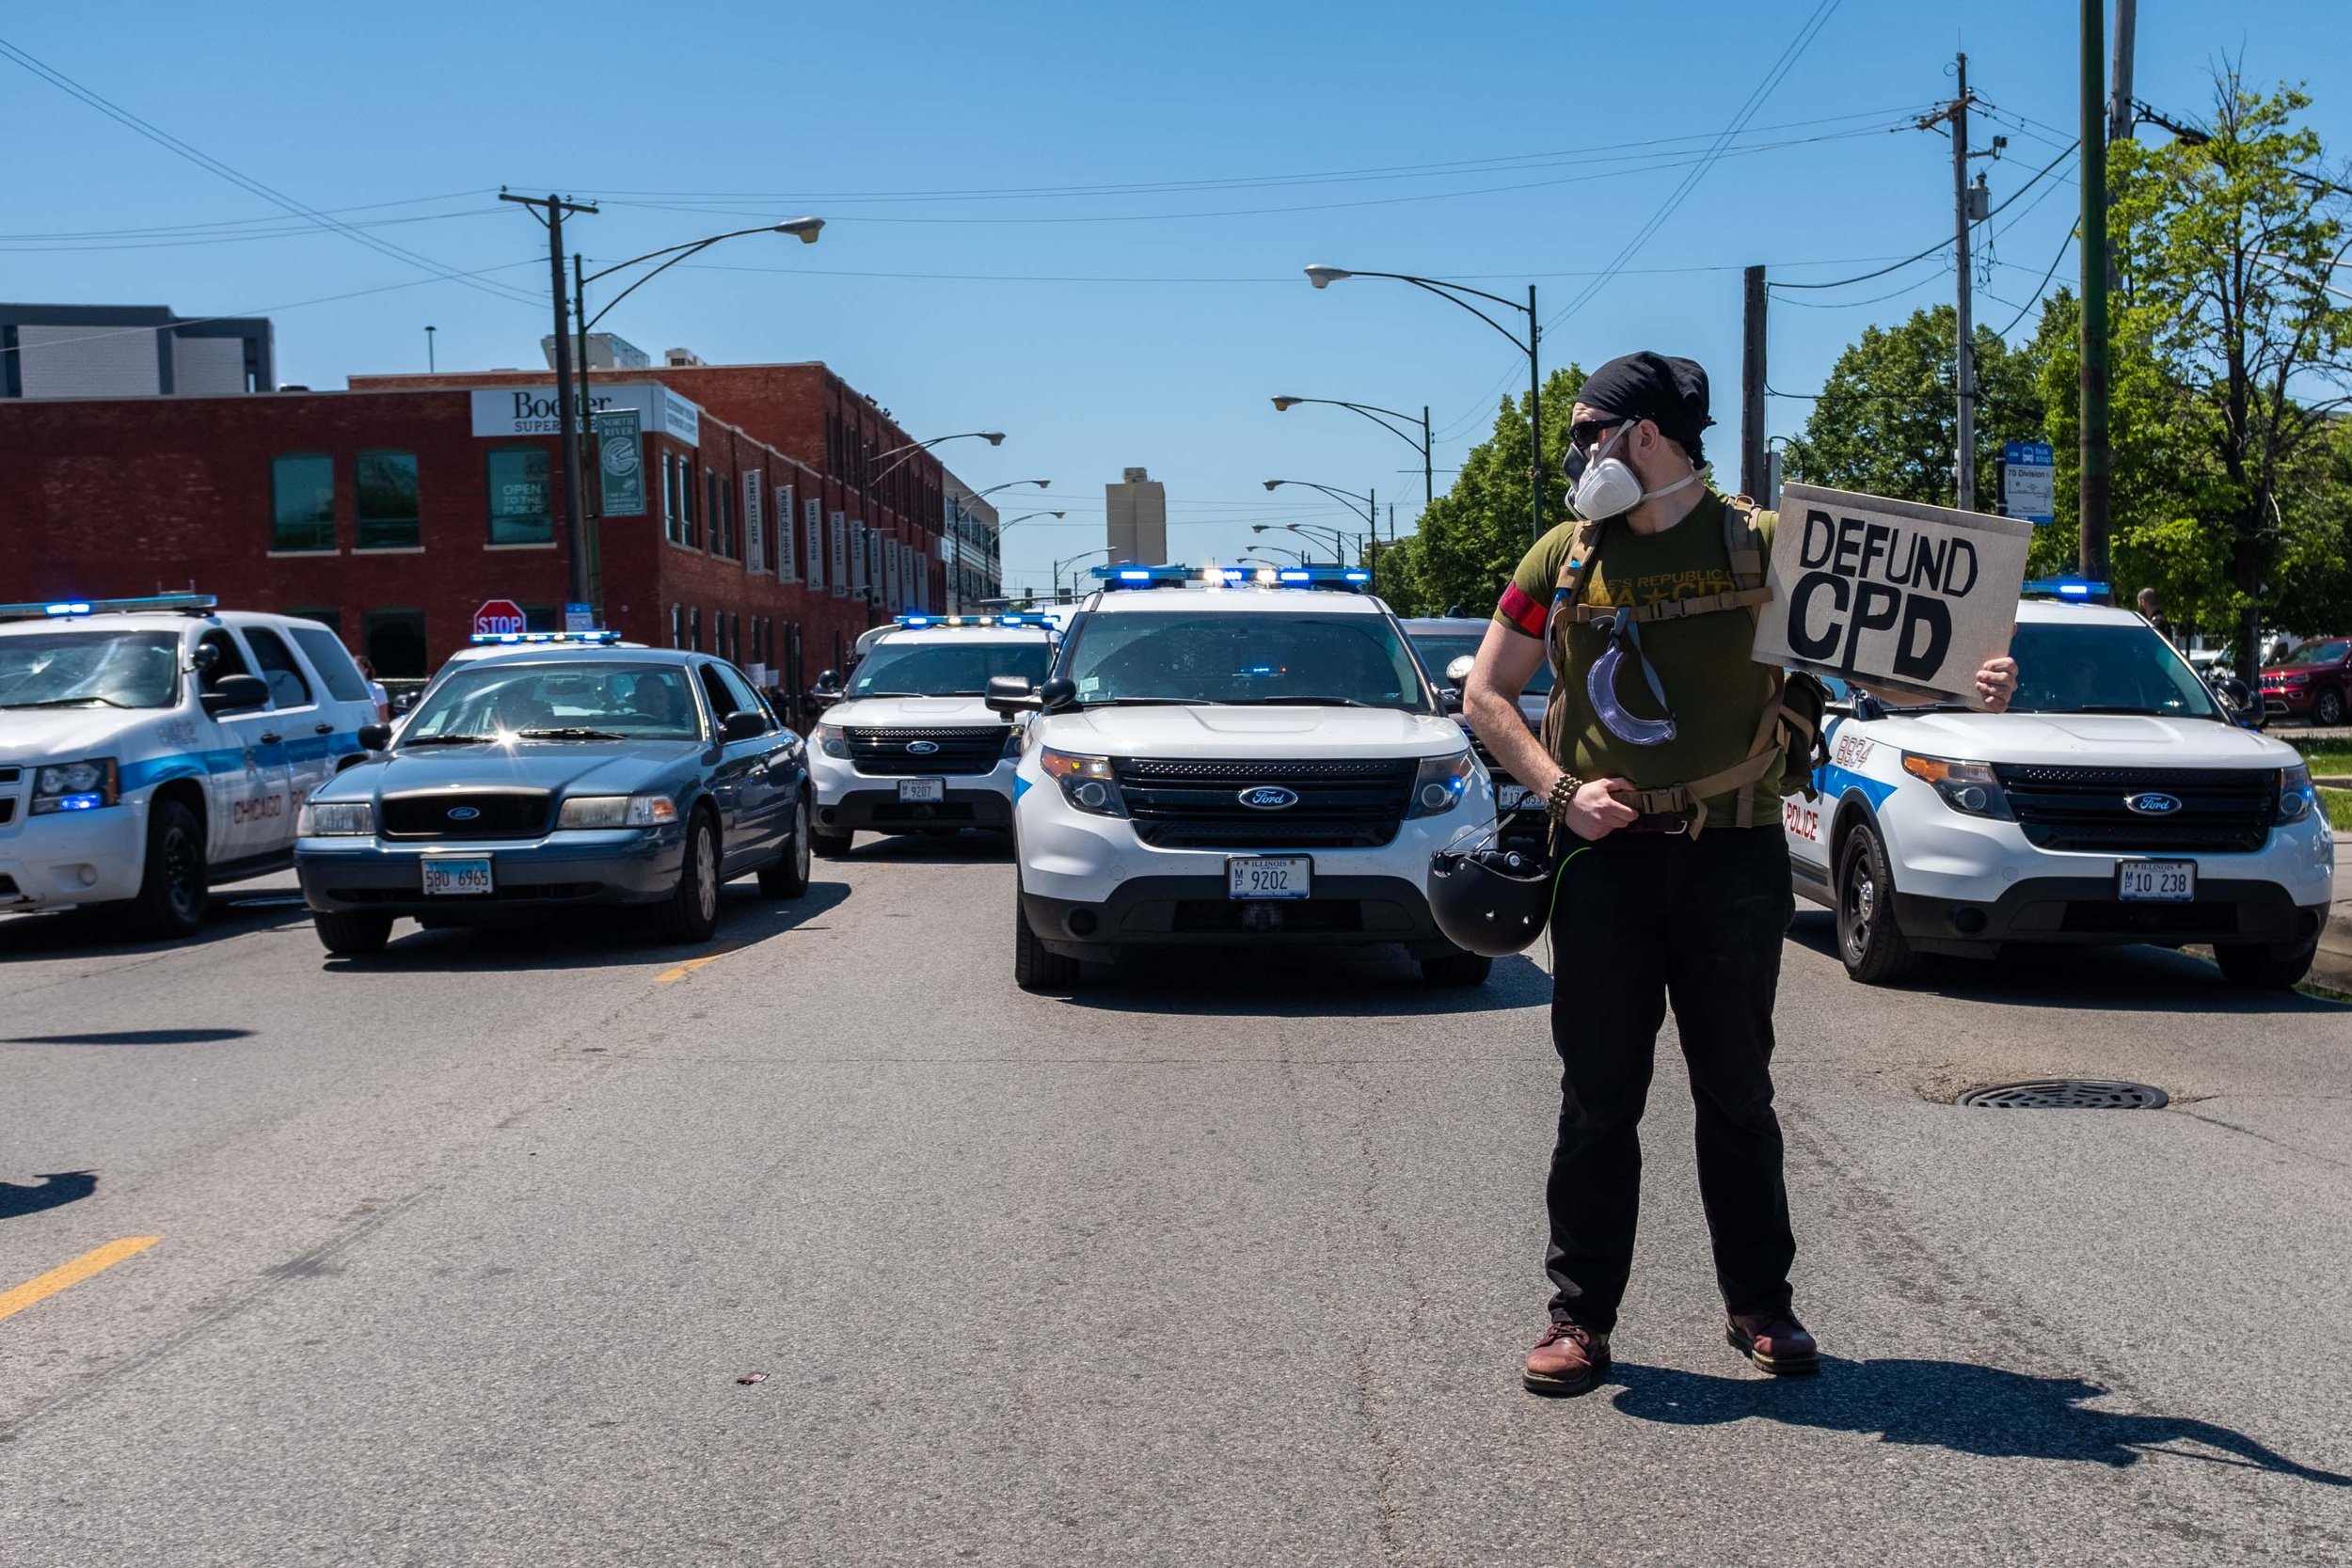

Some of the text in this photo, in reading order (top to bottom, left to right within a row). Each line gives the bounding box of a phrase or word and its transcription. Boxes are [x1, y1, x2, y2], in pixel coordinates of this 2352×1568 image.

[512, 391, 612, 419] Boeter
[603, 427, 634, 436] RIVER
[2008, 468, 2045, 478] 70 Division
[502, 483, 541, 495] OPEN
[504, 495, 542, 505] TO THE
[503, 505, 543, 515] PUBLIC
[809, 502, 818, 561] INSTALLATION
[1799, 509, 1979, 598] DEFUND
[1637, 568, 1724, 587] REPUBLIC
[478, 616, 522, 634] STOP
[1787, 571, 1952, 682] CPD
[1836, 735, 1875, 769] 8934
[911, 785, 931, 798] 9207
[1252, 789, 1285, 804] Ford
[2139, 796, 2169, 810] Ford
[1784, 801, 1819, 842] POLICE
[458, 869, 488, 886] 6965
[1251, 870, 1288, 891] 9202
[2135, 873, 2187, 893] 10 238
